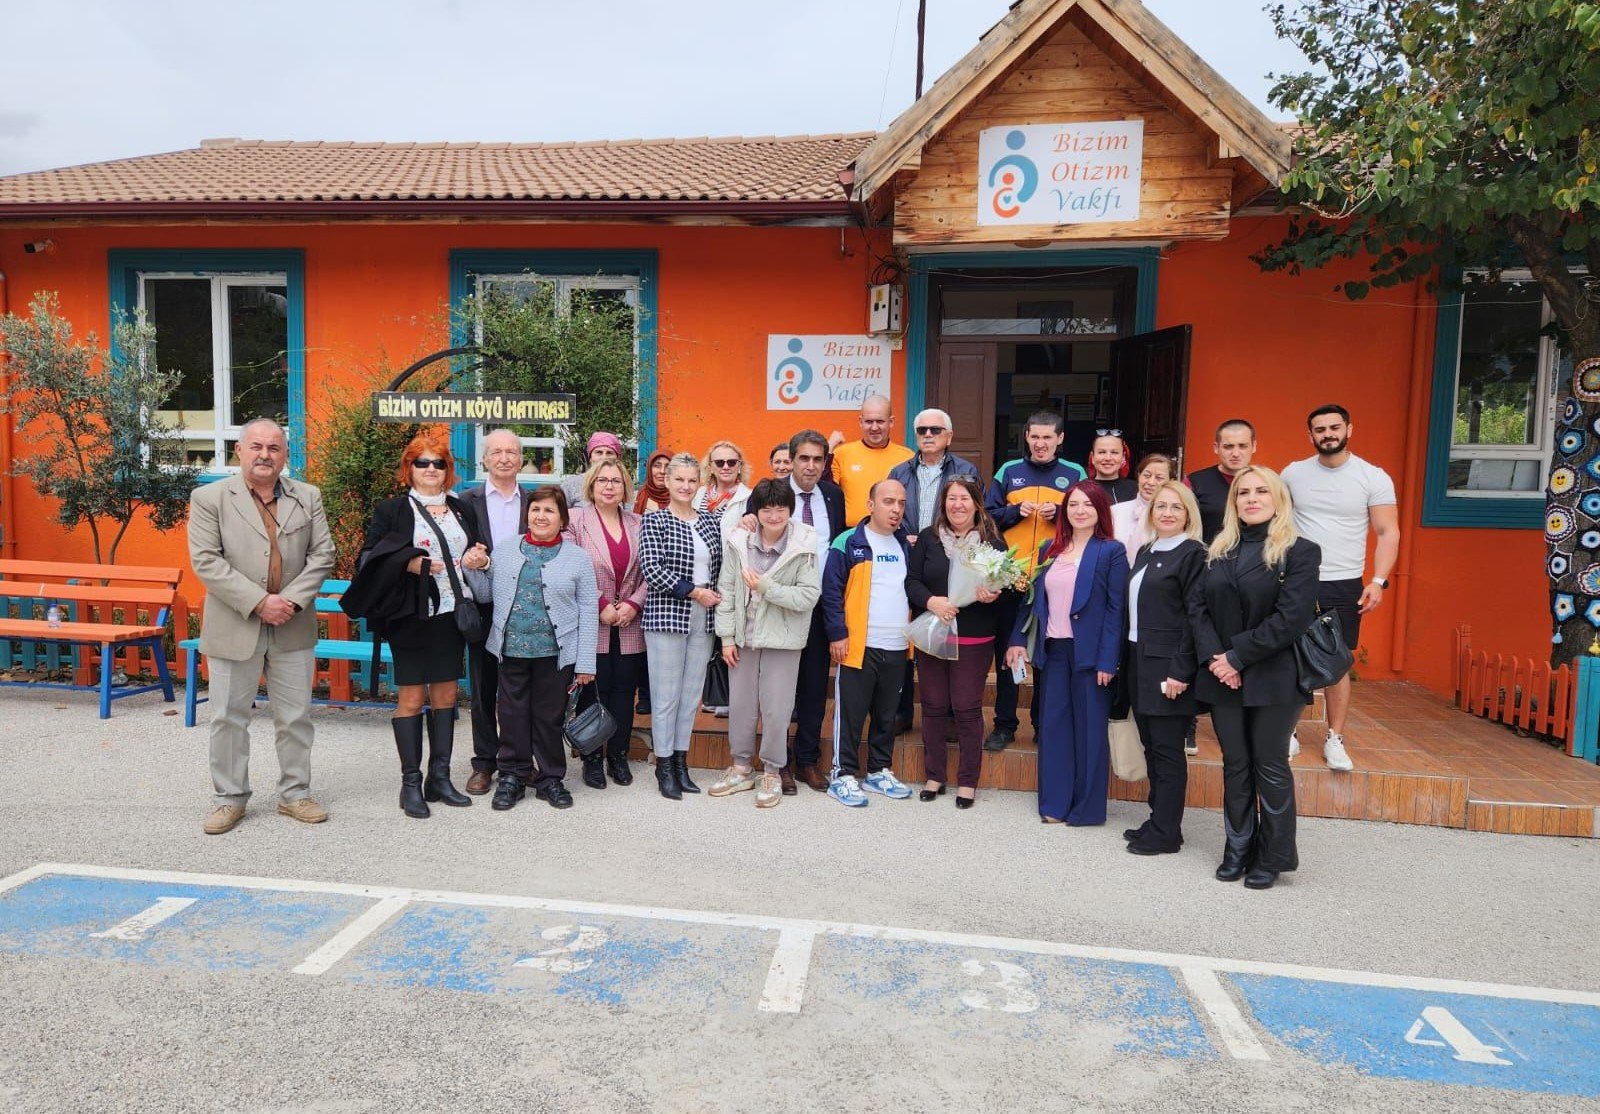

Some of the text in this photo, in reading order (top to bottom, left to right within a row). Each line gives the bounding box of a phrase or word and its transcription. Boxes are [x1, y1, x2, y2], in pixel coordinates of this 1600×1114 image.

[1052, 130, 1129, 153] Bizim
[1051, 161, 1129, 182] Otizm
[1051, 186, 1122, 217] Vakfı
[823, 340, 882, 357] Bizim
[822, 363, 882, 379] Otizm
[378, 395, 570, 420] BİZİM OTİZM KÖYÜ HATIRASI
[88, 896, 199, 940] 1
[511, 924, 609, 974] 2
[960, 959, 1041, 1013] 3
[1403, 1006, 1514, 1066] 4
